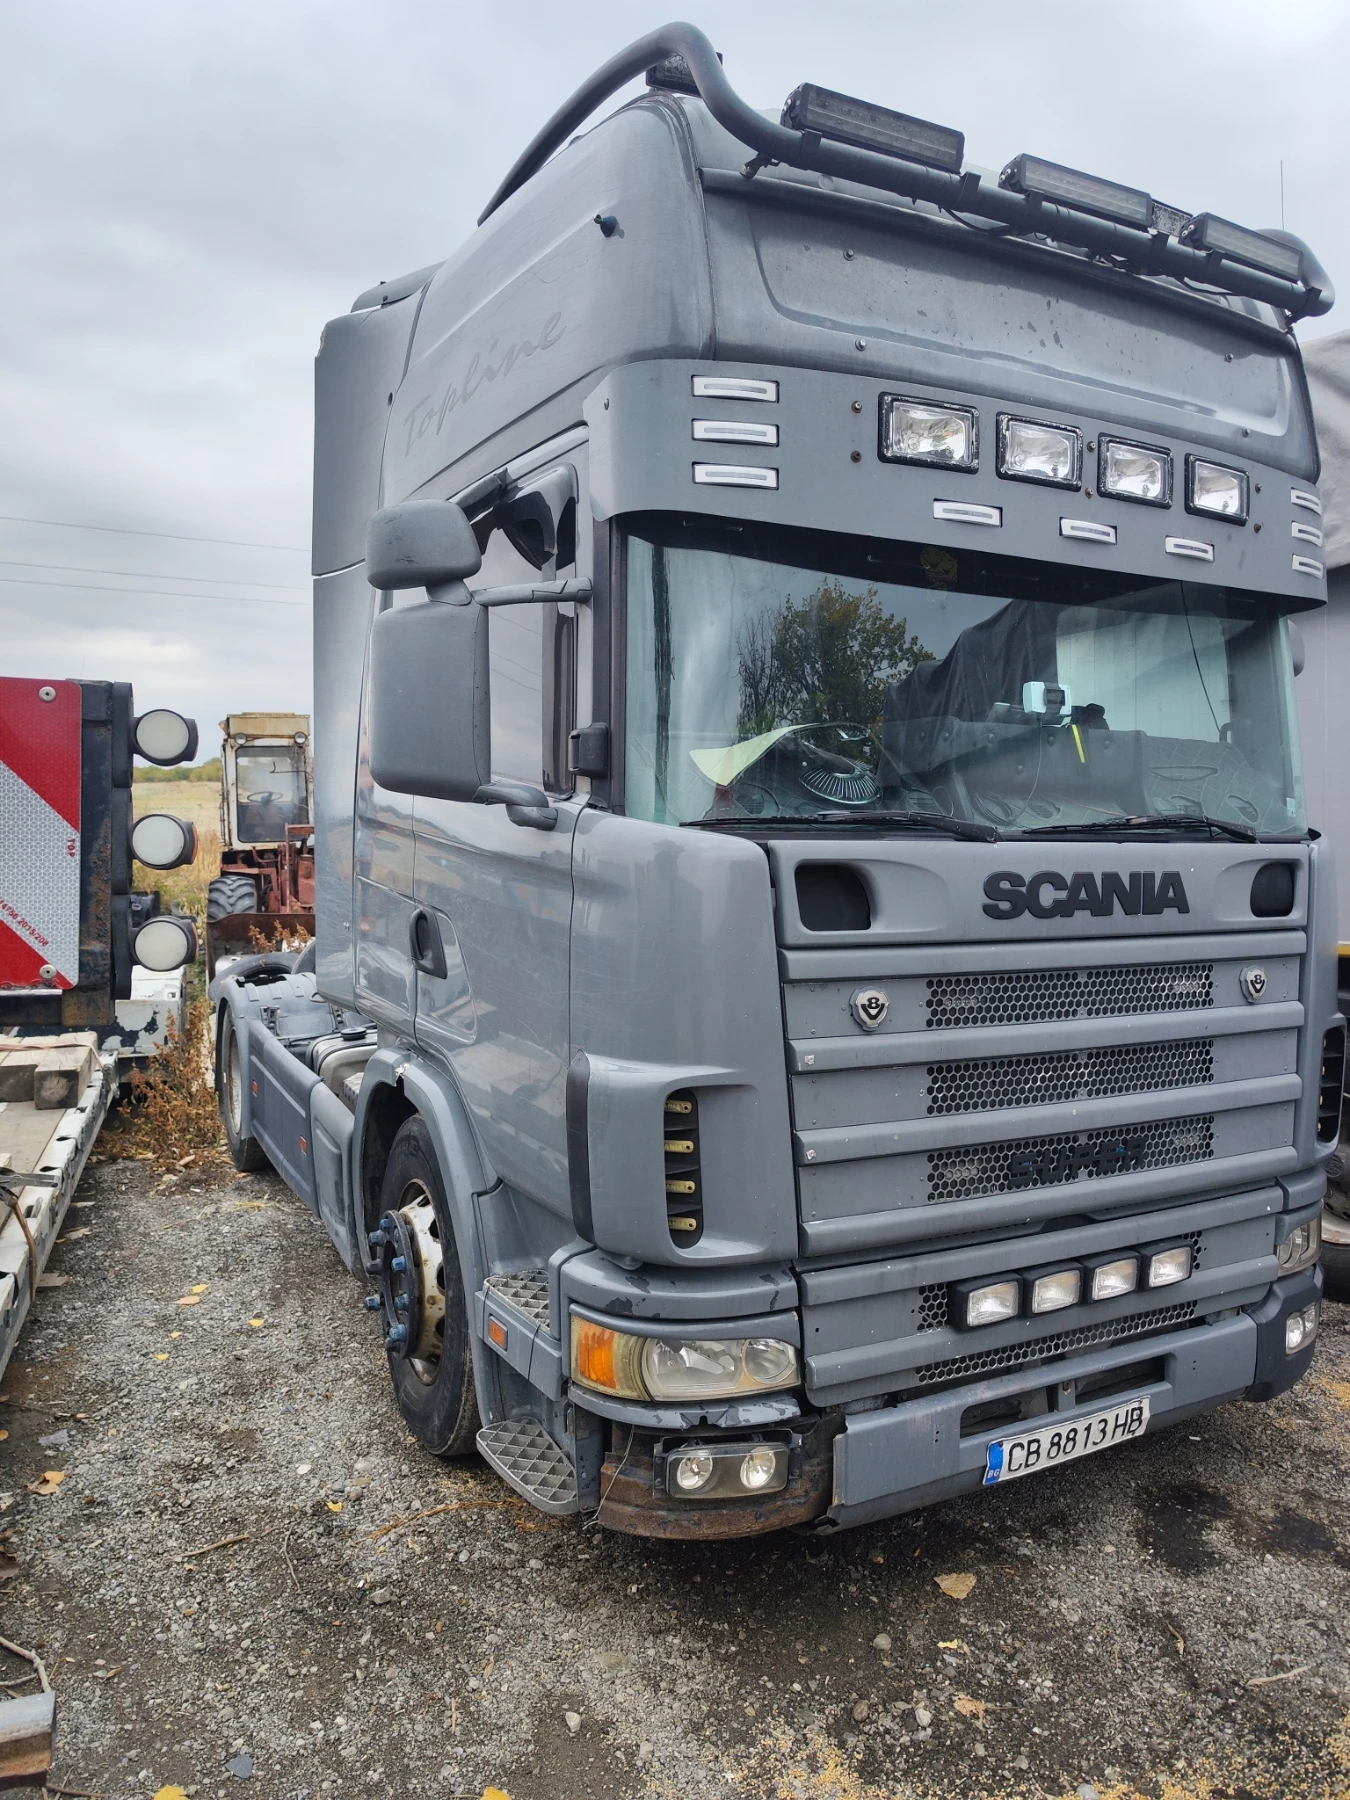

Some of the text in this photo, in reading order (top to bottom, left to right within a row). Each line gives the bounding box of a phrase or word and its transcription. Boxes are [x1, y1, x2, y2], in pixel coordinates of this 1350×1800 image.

[403, 311, 567, 458] Topline
[67, 838, 76, 858] TOP
[982, 870, 1190, 920] SCANIA
[1008, 1136, 1149, 1188] SUPER
[1007, 1405, 1144, 1472] CB 8813 HB
[987, 1468, 1000, 1478] BG
